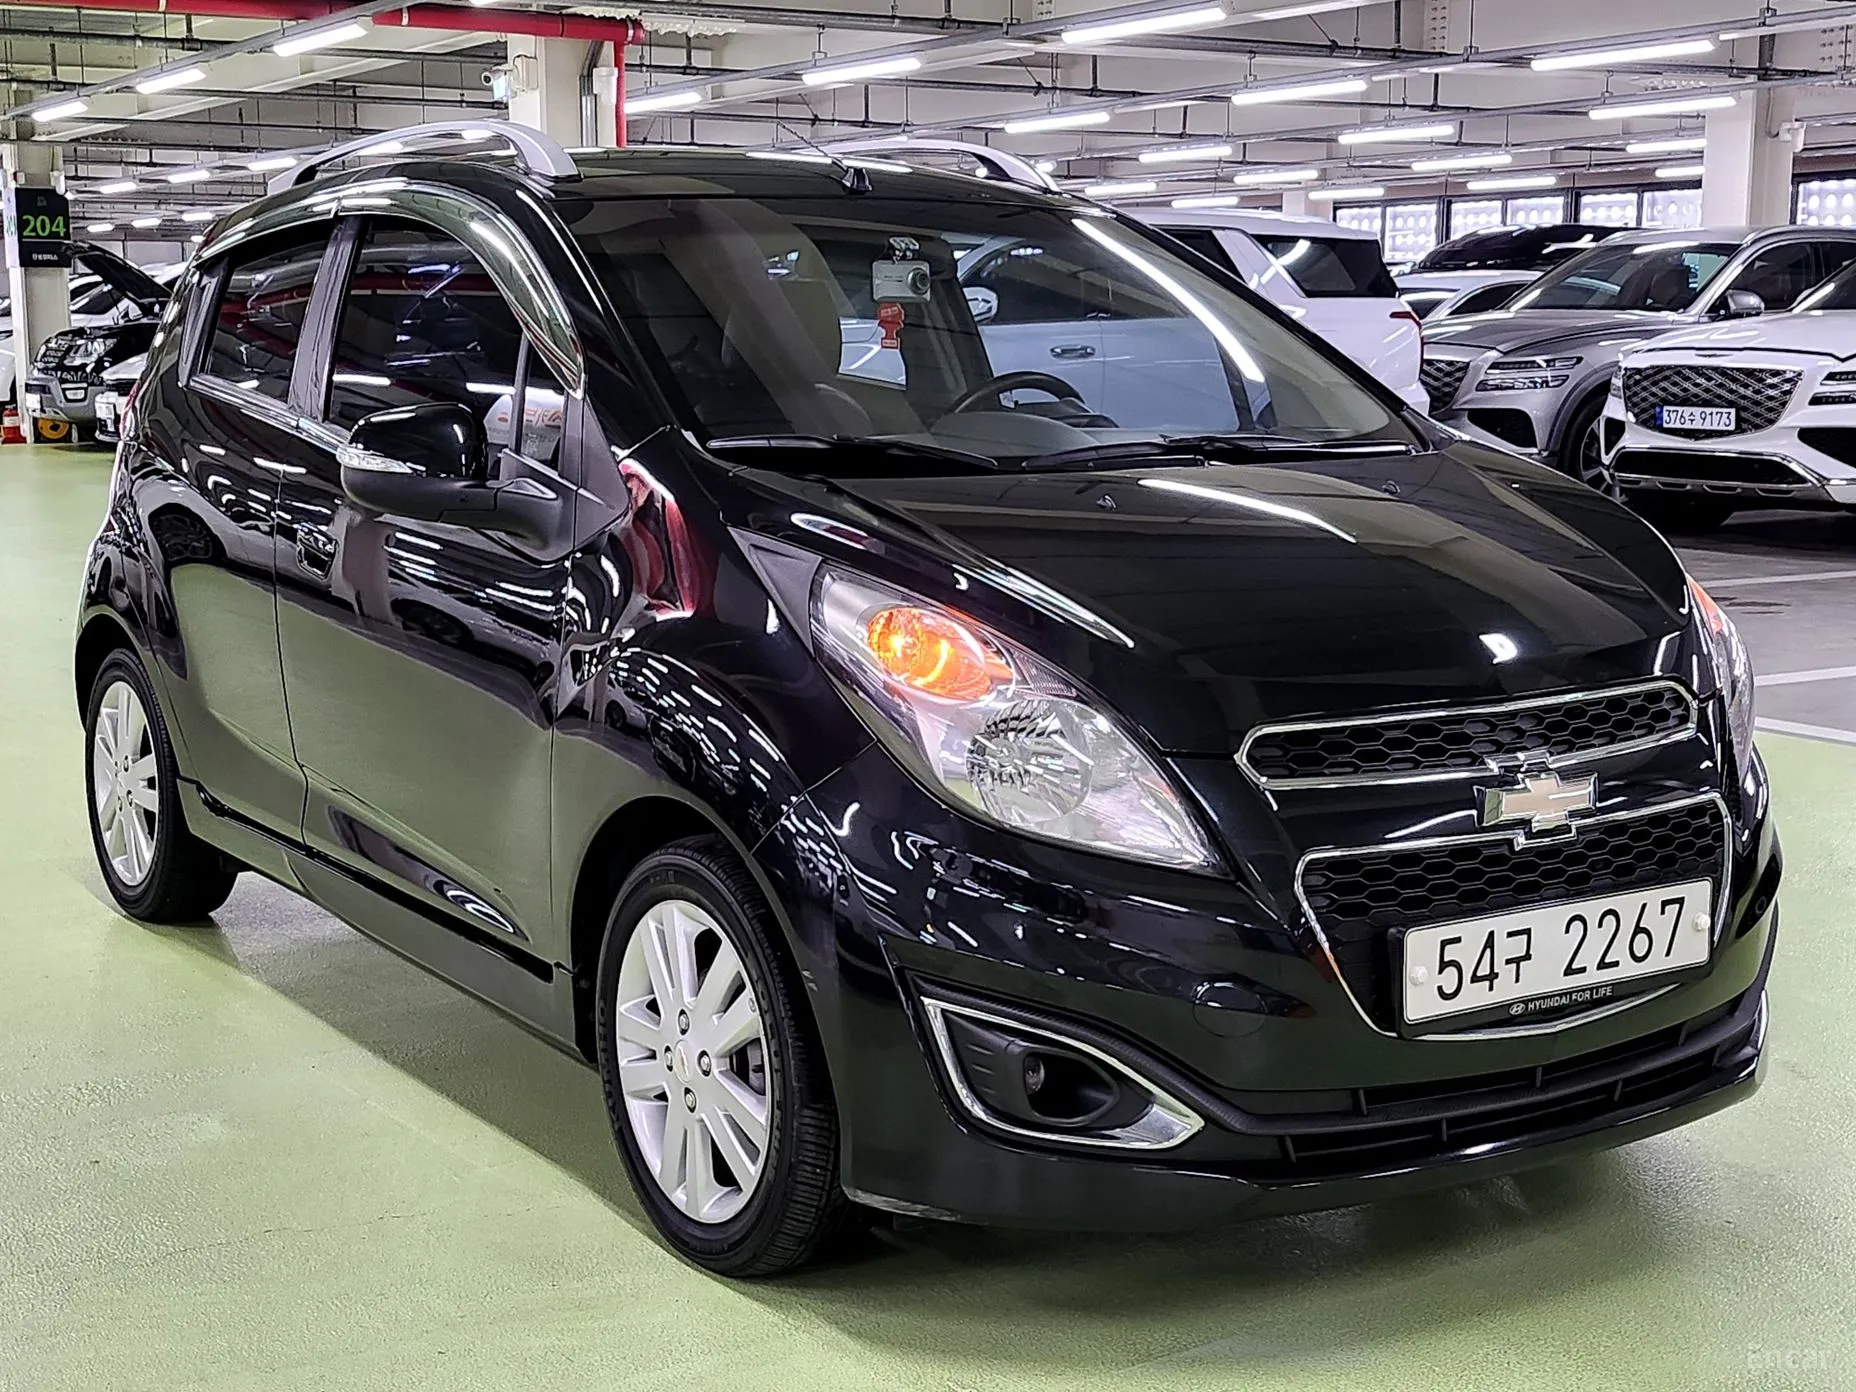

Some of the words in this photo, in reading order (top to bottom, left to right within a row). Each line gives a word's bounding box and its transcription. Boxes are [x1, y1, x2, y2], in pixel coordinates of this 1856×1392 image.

[22, 214, 66, 237] 204
[1664, 409, 1696, 426] 376수
[1699, 410, 1732, 428] 9173
[1436, 926, 1533, 1001] 54구
[1562, 896, 1686, 977] 2267
[1527, 994, 1570, 1012] HYUNDAI
[1571, 990, 1591, 1001] FOR
[1592, 986, 1613, 999] LIFE
